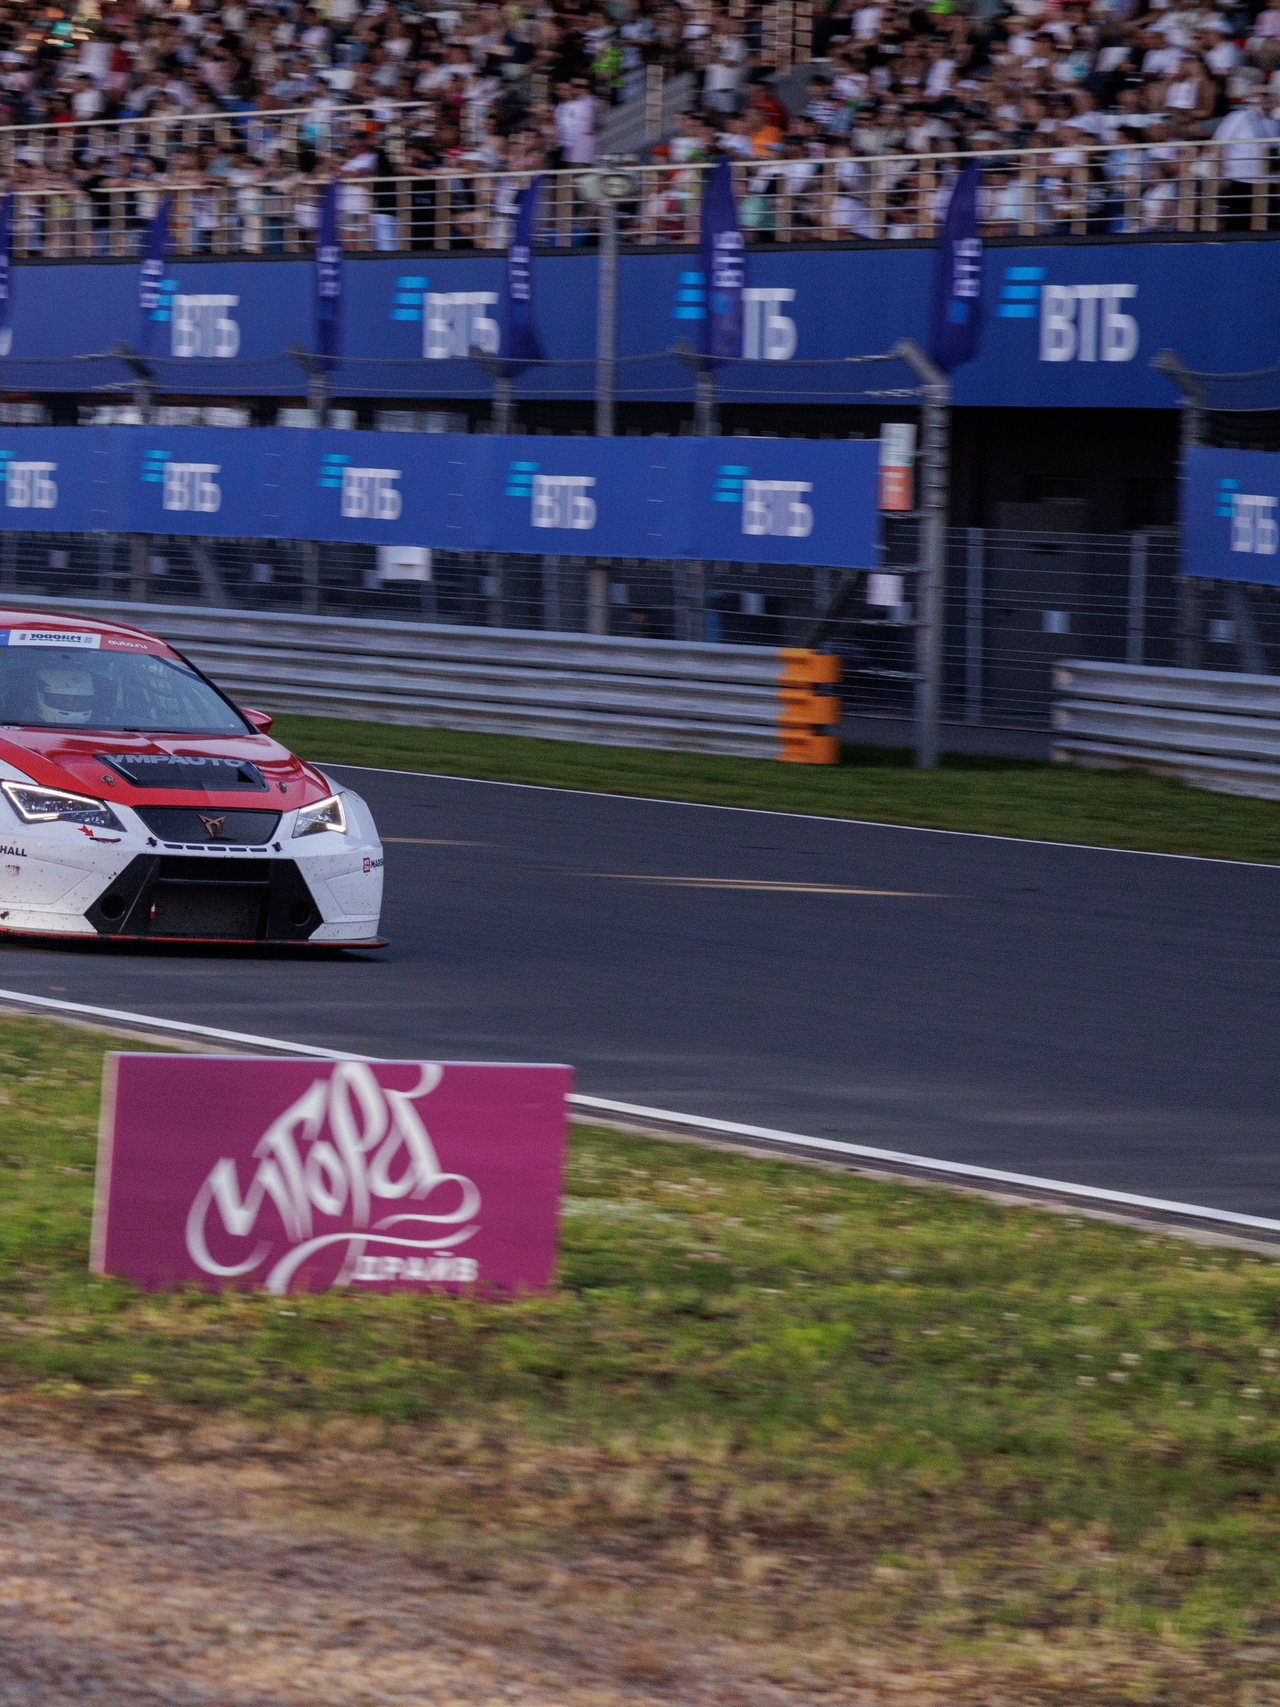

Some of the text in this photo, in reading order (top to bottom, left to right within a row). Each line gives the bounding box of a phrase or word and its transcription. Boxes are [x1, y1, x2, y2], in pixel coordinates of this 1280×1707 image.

[171, 294, 240, 357] ВТБ
[423, 291, 500, 359] ВТБ
[741, 287, 799, 361] ТБ
[1039, 283, 1140, 362] ВТБ
[5, 460, 58, 509] ВТБ
[162, 462, 221, 513] ВТБ
[340, 466, 402, 520] ВТБ
[530, 474, 597, 530] ВТБ
[741, 479, 815, 538] ВТБ
[107, 639, 148, 650] auto.ru
[104, 754, 246, 768] VMPAUTO
